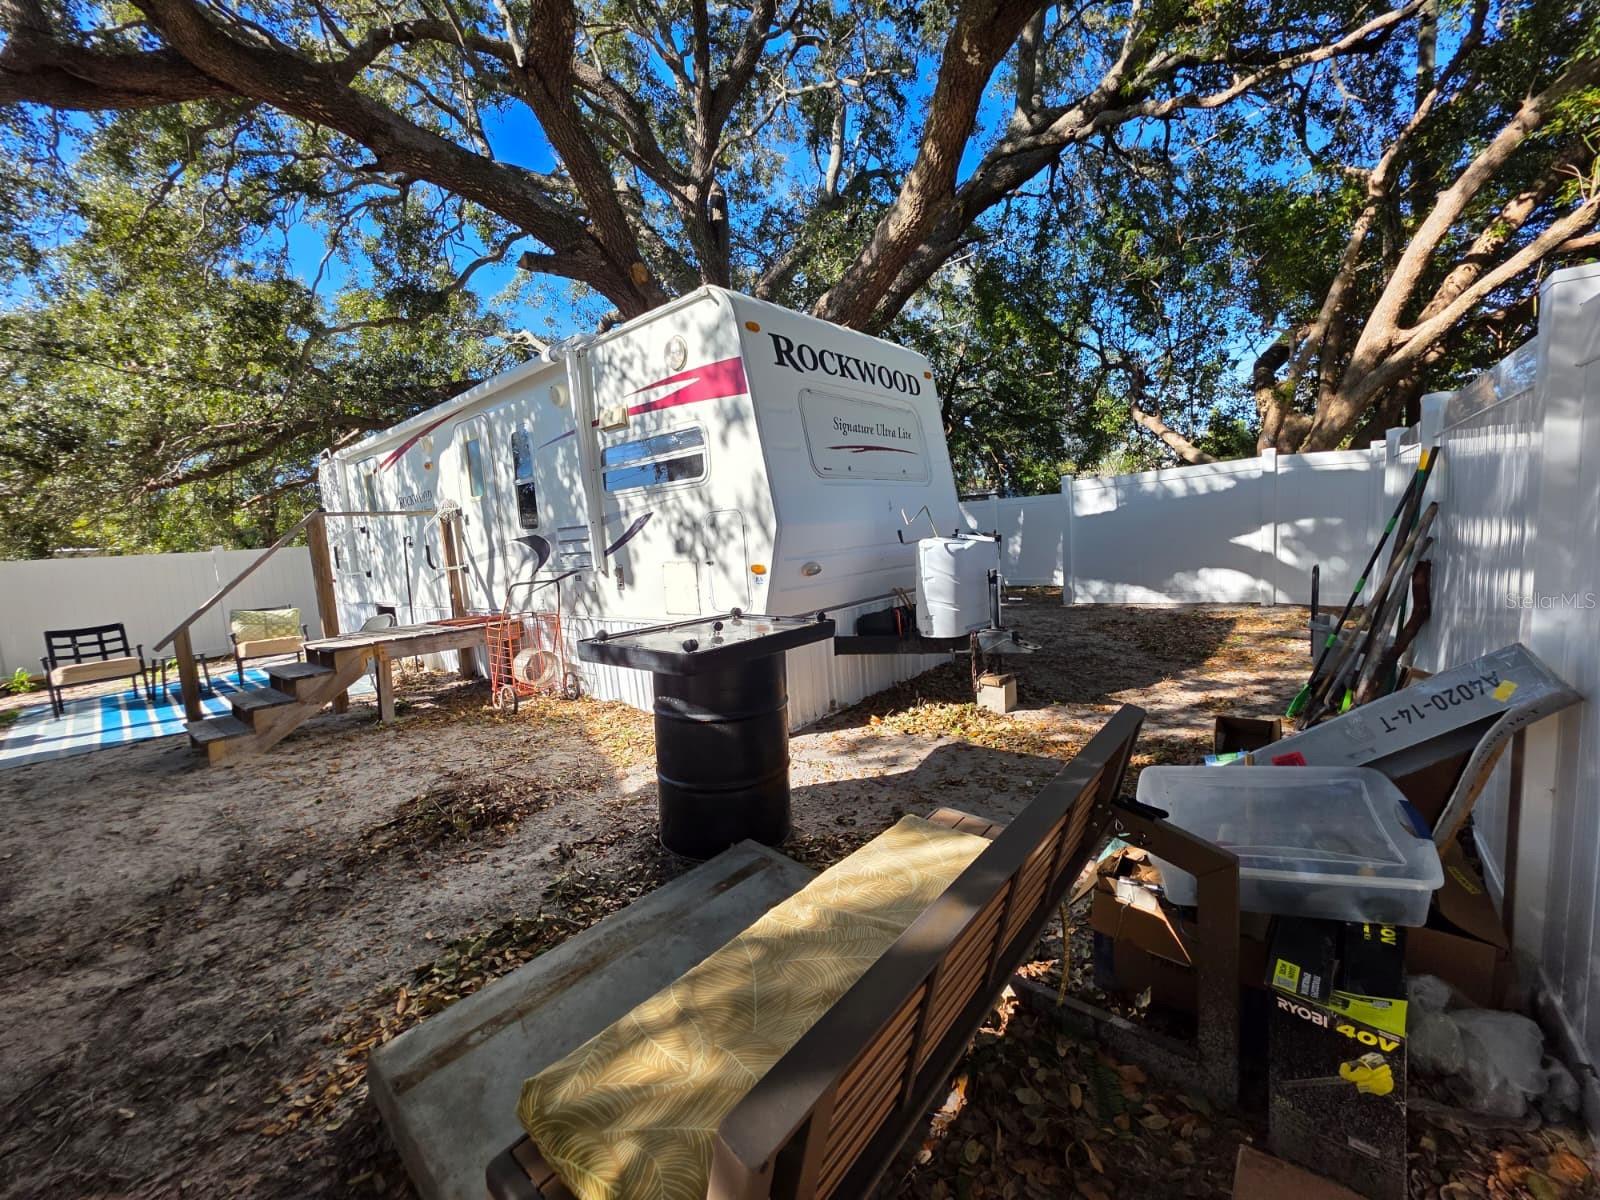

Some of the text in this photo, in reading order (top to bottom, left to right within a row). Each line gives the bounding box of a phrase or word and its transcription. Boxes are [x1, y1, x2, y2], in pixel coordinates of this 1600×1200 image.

[768, 333, 921, 396] ROCKWOOD
[833, 416, 912, 439] Signature Ultra Lite
[1380, 670, 1500, 733] A4020-14-T
[1380, 924, 1396, 946] 0V
[1276, 996, 1400, 1052] RYOBI 40V
